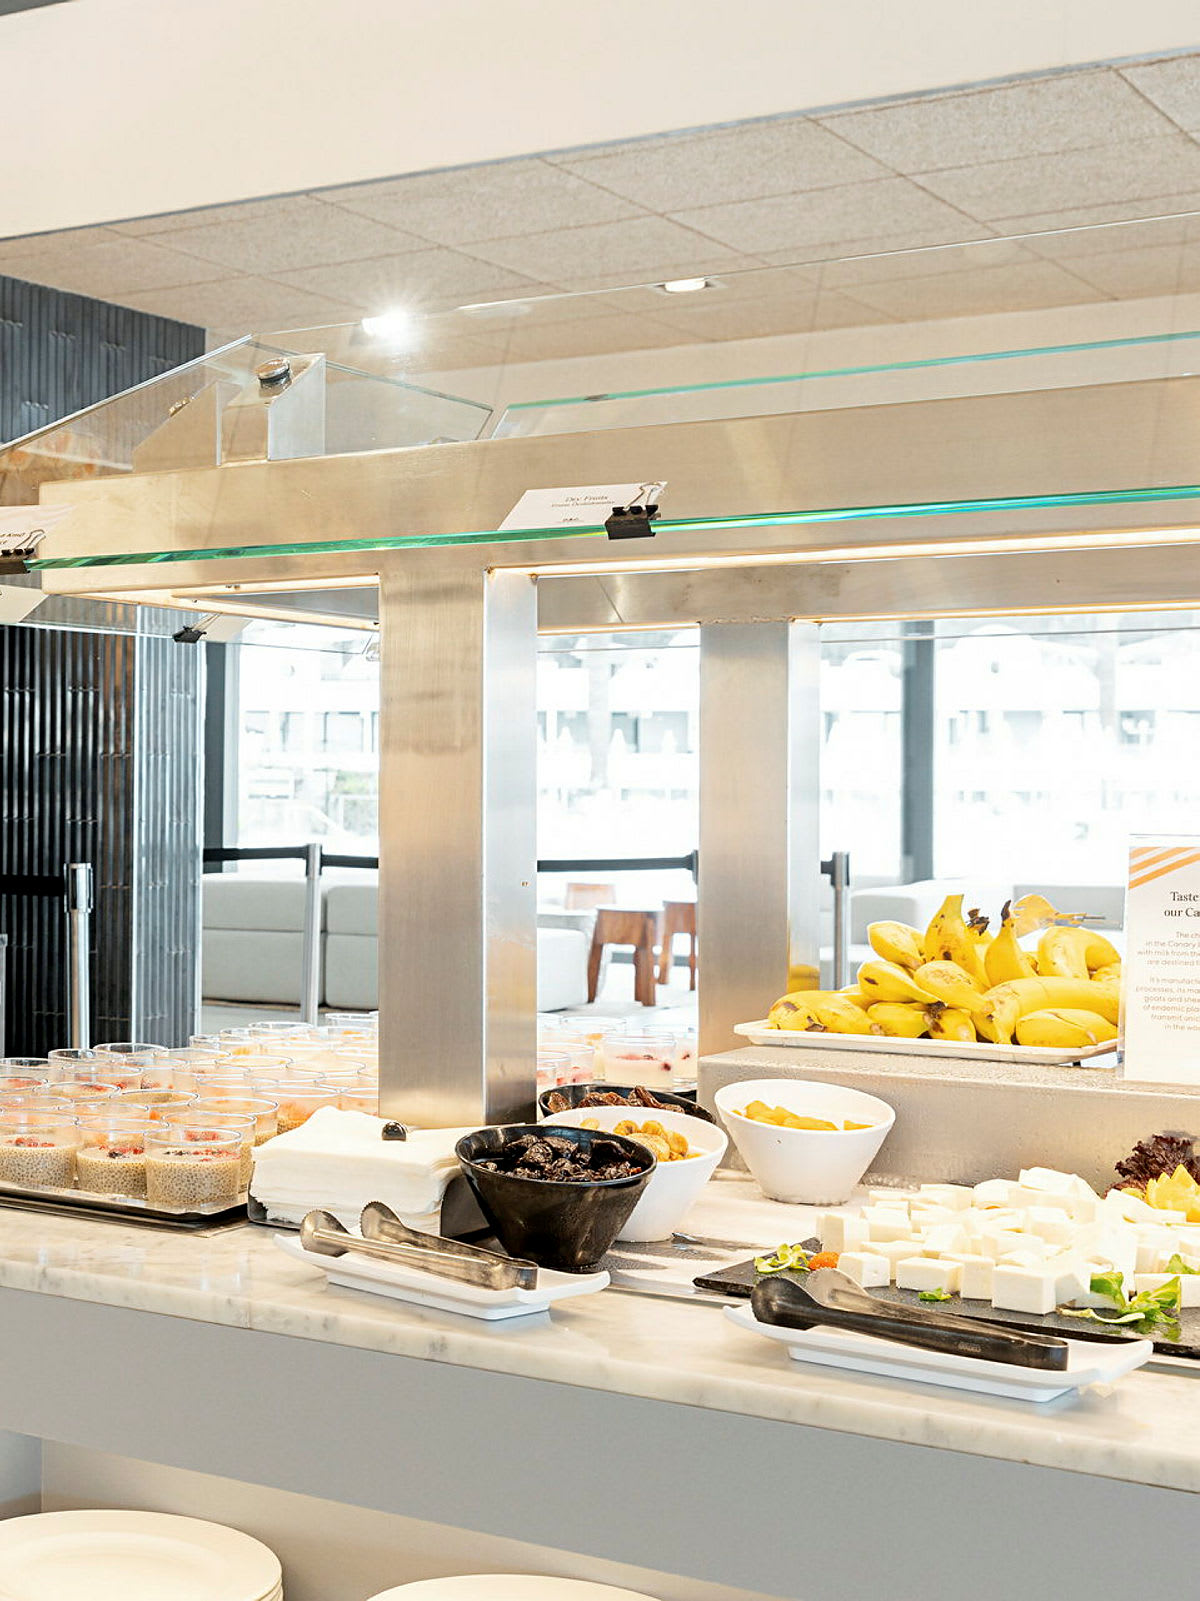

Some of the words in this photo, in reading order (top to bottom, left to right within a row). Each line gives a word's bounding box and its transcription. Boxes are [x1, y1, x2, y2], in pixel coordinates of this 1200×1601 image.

[1170, 891, 1199, 902] Taste
[1164, 909, 1183, 917] our
[1176, 931, 1189, 939] The
[1168, 940, 1196, 950] Canary
[1144, 996, 1165, 1004] goats
[1151, 1013, 1183, 1022] transmit
